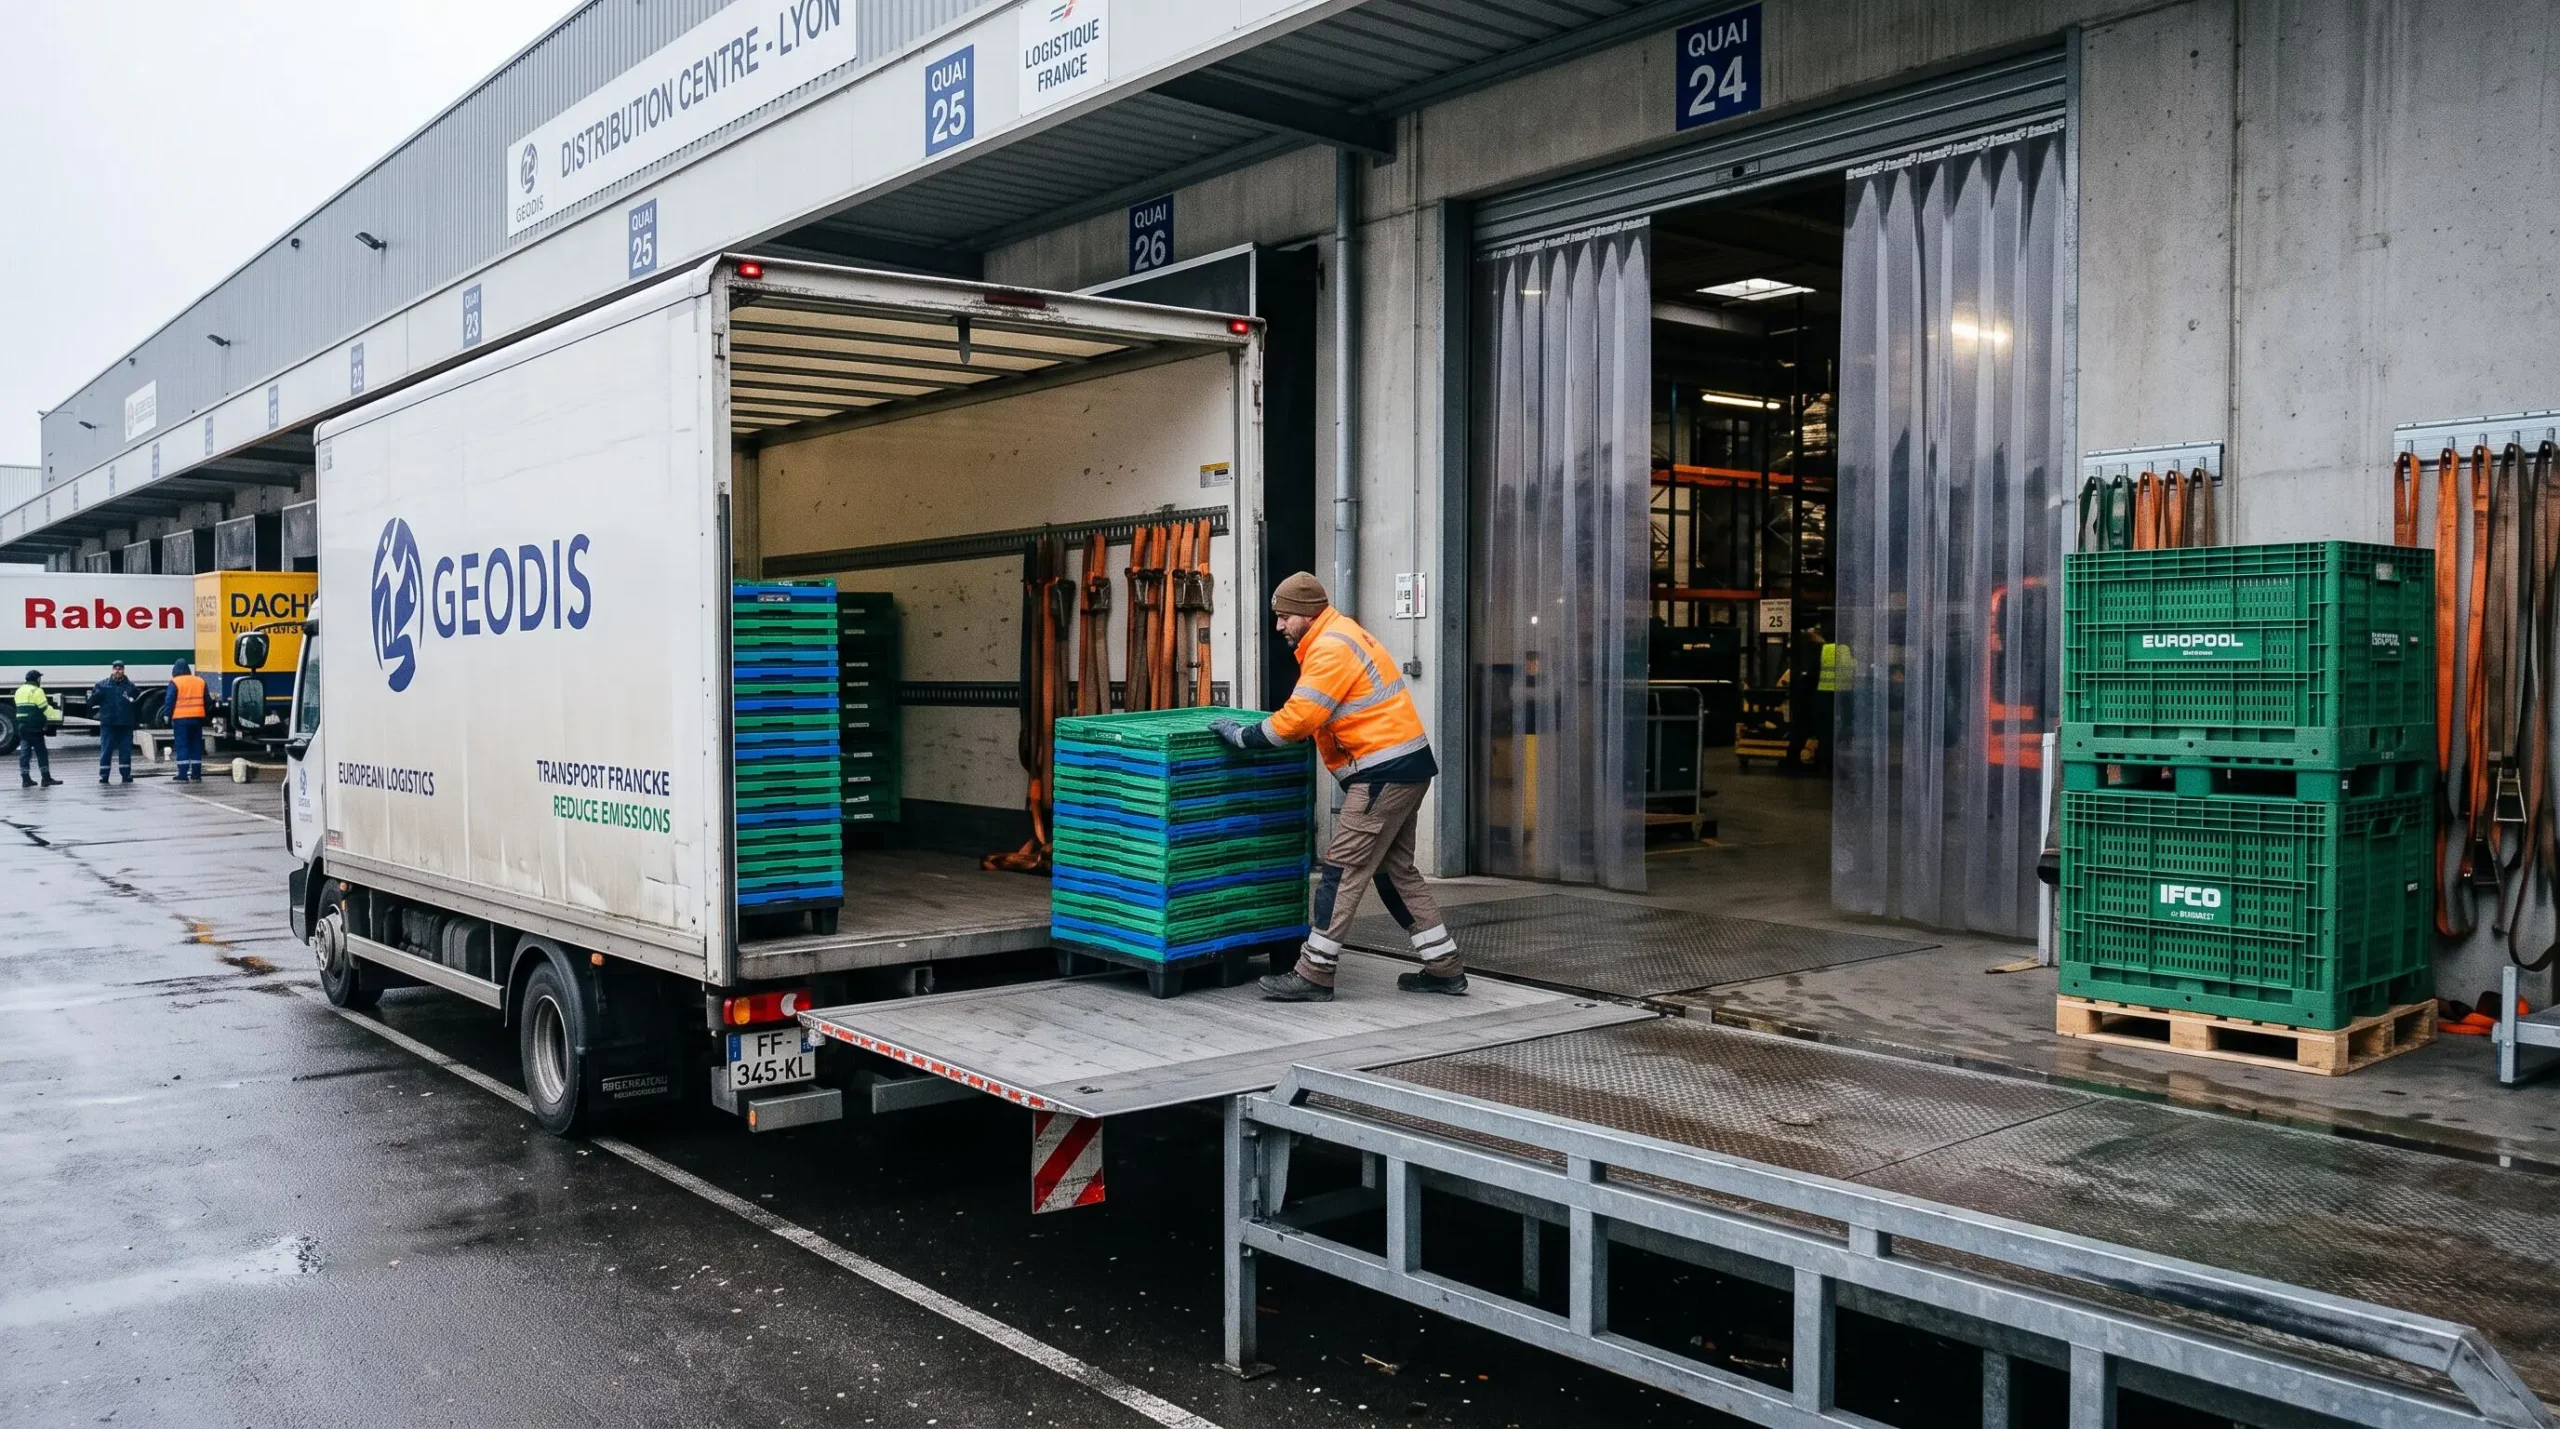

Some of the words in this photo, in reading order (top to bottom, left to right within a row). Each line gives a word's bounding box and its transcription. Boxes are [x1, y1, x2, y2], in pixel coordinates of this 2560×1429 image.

[1025, 18, 1100, 70] LOGISTIQUE
[1687, 18, 1748, 57] QUAI
[562, 78, 673, 178] DISTRIBUTION
[679, 26, 759, 111] CENTRE
[779, 0, 840, 56] LYON
[931, 57, 967, 92] QUAI
[1037, 53, 1088, 93] FRANCE
[1688, 55, 1747, 117] 24
[932, 89, 967, 145] 25
[516, 194, 544, 223] GEODIS
[631, 206, 653, 231] QUAI
[1134, 203, 1167, 229] QUAI
[632, 231, 653, 270] 25
[1134, 229, 1167, 272] 26
[466, 310, 480, 341] 23
[431, 533, 592, 639] GEODIS
[24, 597, 185, 630] Raben
[231, 592, 317, 619] DACH
[1769, 615, 1784, 628] 25
[2142, 633, 2244, 648] EUROPOOL
[338, 761, 385, 790] EUROPEAN
[386, 767, 435, 797] LOGISTICS
[537, 759, 606, 789] TRANSPORT
[608, 766, 670, 797] FRANCKE
[553, 795, 599, 824] REDUCE
[601, 801, 671, 834] EMISSIONS
[2160, 884, 2221, 908] IFCO
[736, 1056, 812, 1086] 345-KL
